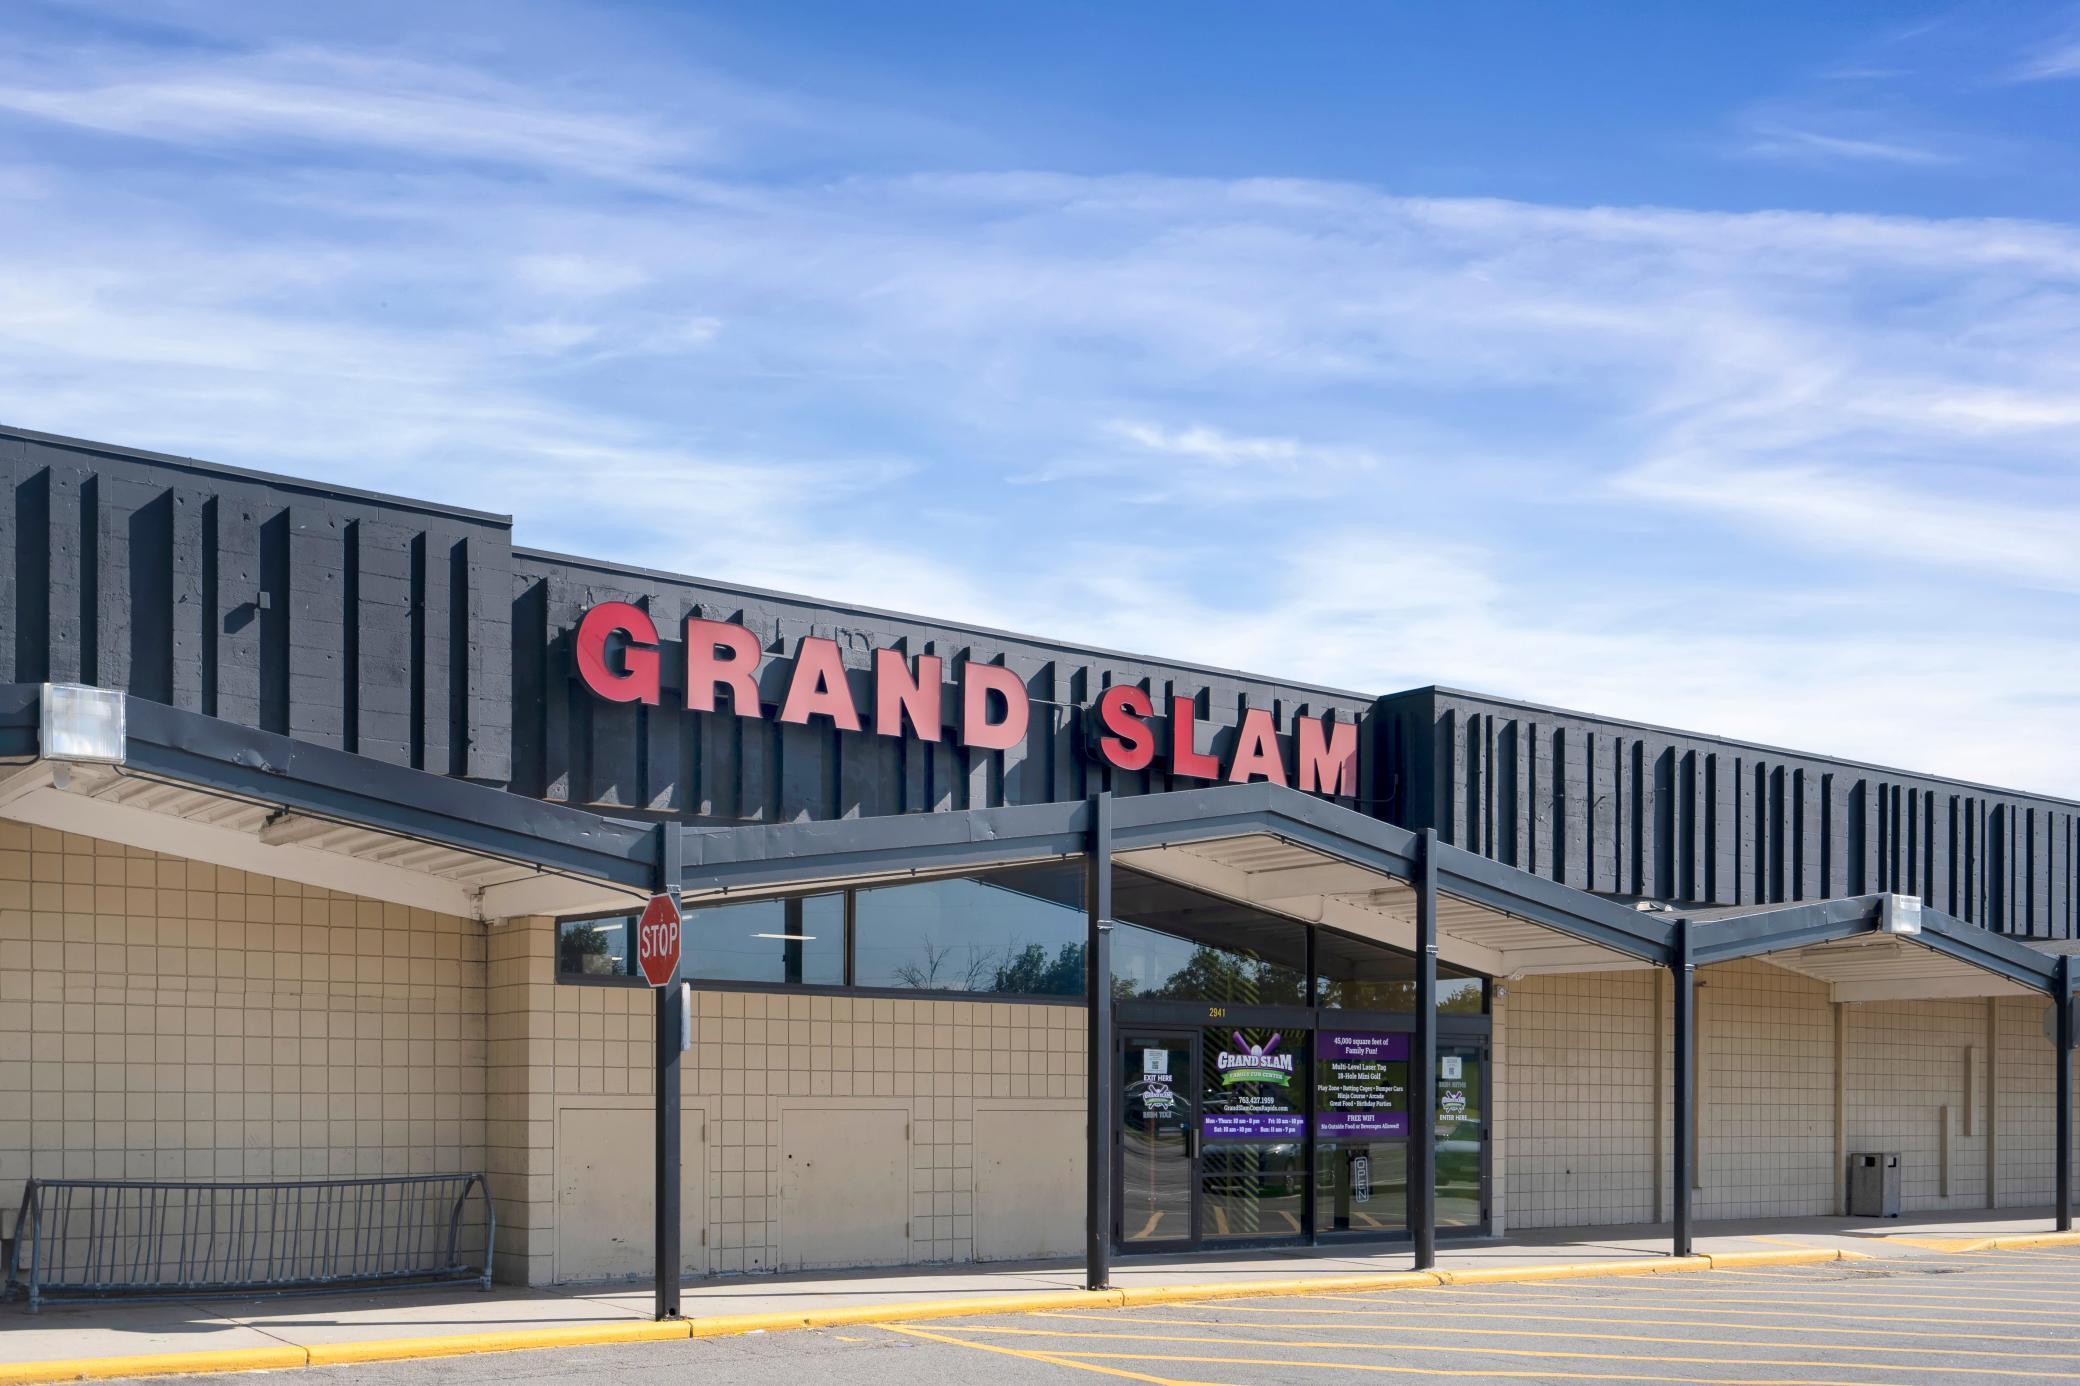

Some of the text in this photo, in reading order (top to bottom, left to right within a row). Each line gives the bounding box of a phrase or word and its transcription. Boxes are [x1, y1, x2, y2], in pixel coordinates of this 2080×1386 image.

[576, 601, 1358, 798] GRAND SLAM
[642, 922, 678, 958] STOP
[1209, 1008, 1226, 1018] 2941
[1334, 1037, 1352, 1045] 45,000
[1345, 1047, 1364, 1055] Family
[1218, 1051, 1293, 1071] GRAND SLAM
[1357, 1160, 1366, 1200] OPEN
